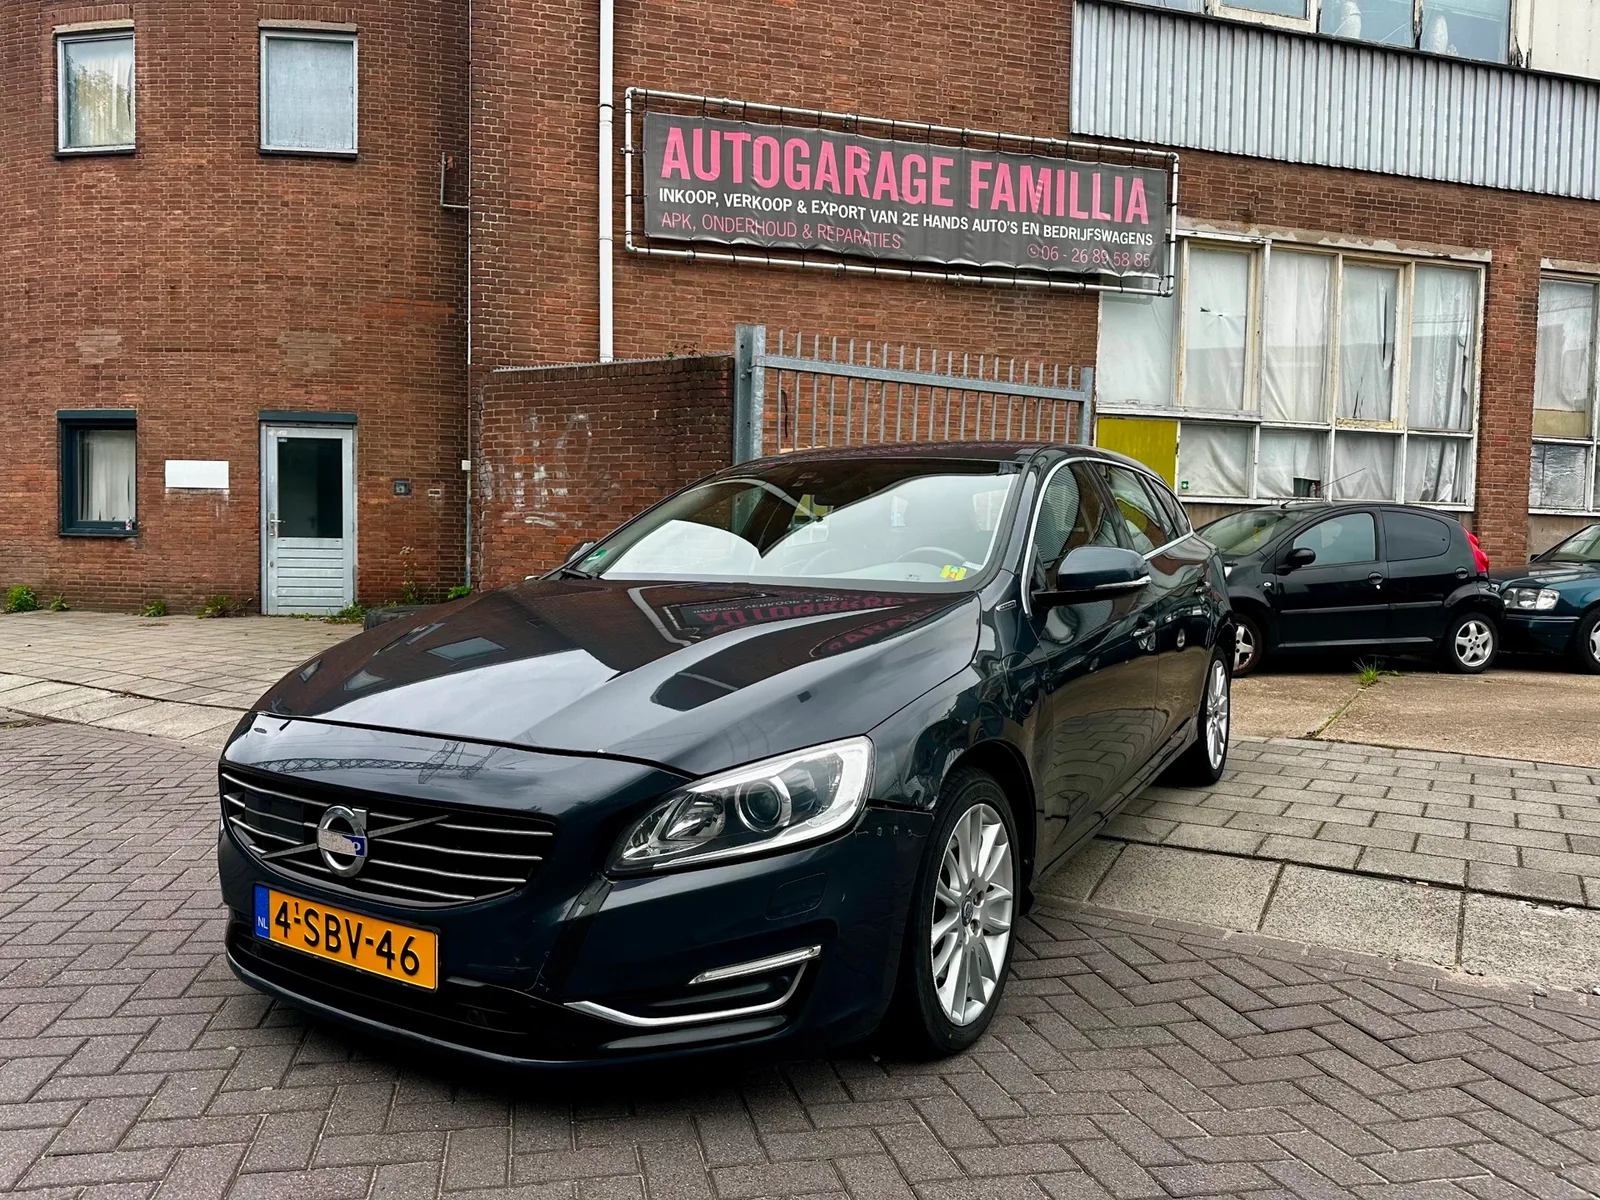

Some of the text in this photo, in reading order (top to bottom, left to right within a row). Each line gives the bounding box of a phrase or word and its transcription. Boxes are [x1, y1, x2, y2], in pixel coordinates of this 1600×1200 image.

[661, 126, 1149, 225] AUTOGARAGE FAMILLIA
[659, 187, 1153, 246] INKOOP, VERKOOP & EXPORT VAN 2E HANDS AUTO'S EN BEDRIJFSWAGENS
[661, 211, 901, 249] APK, ONDERHOUD & REPARATIES
[1042, 245, 1059, 261] 06
[1071, 247, 1088, 263] 26
[1092, 249, 1108, 265] 89
[1113, 251, 1130, 267] 58
[1134, 252, 1151, 268] 85
[257, 916, 268, 930] NL
[275, 901, 419, 976] 4-SBV-46
